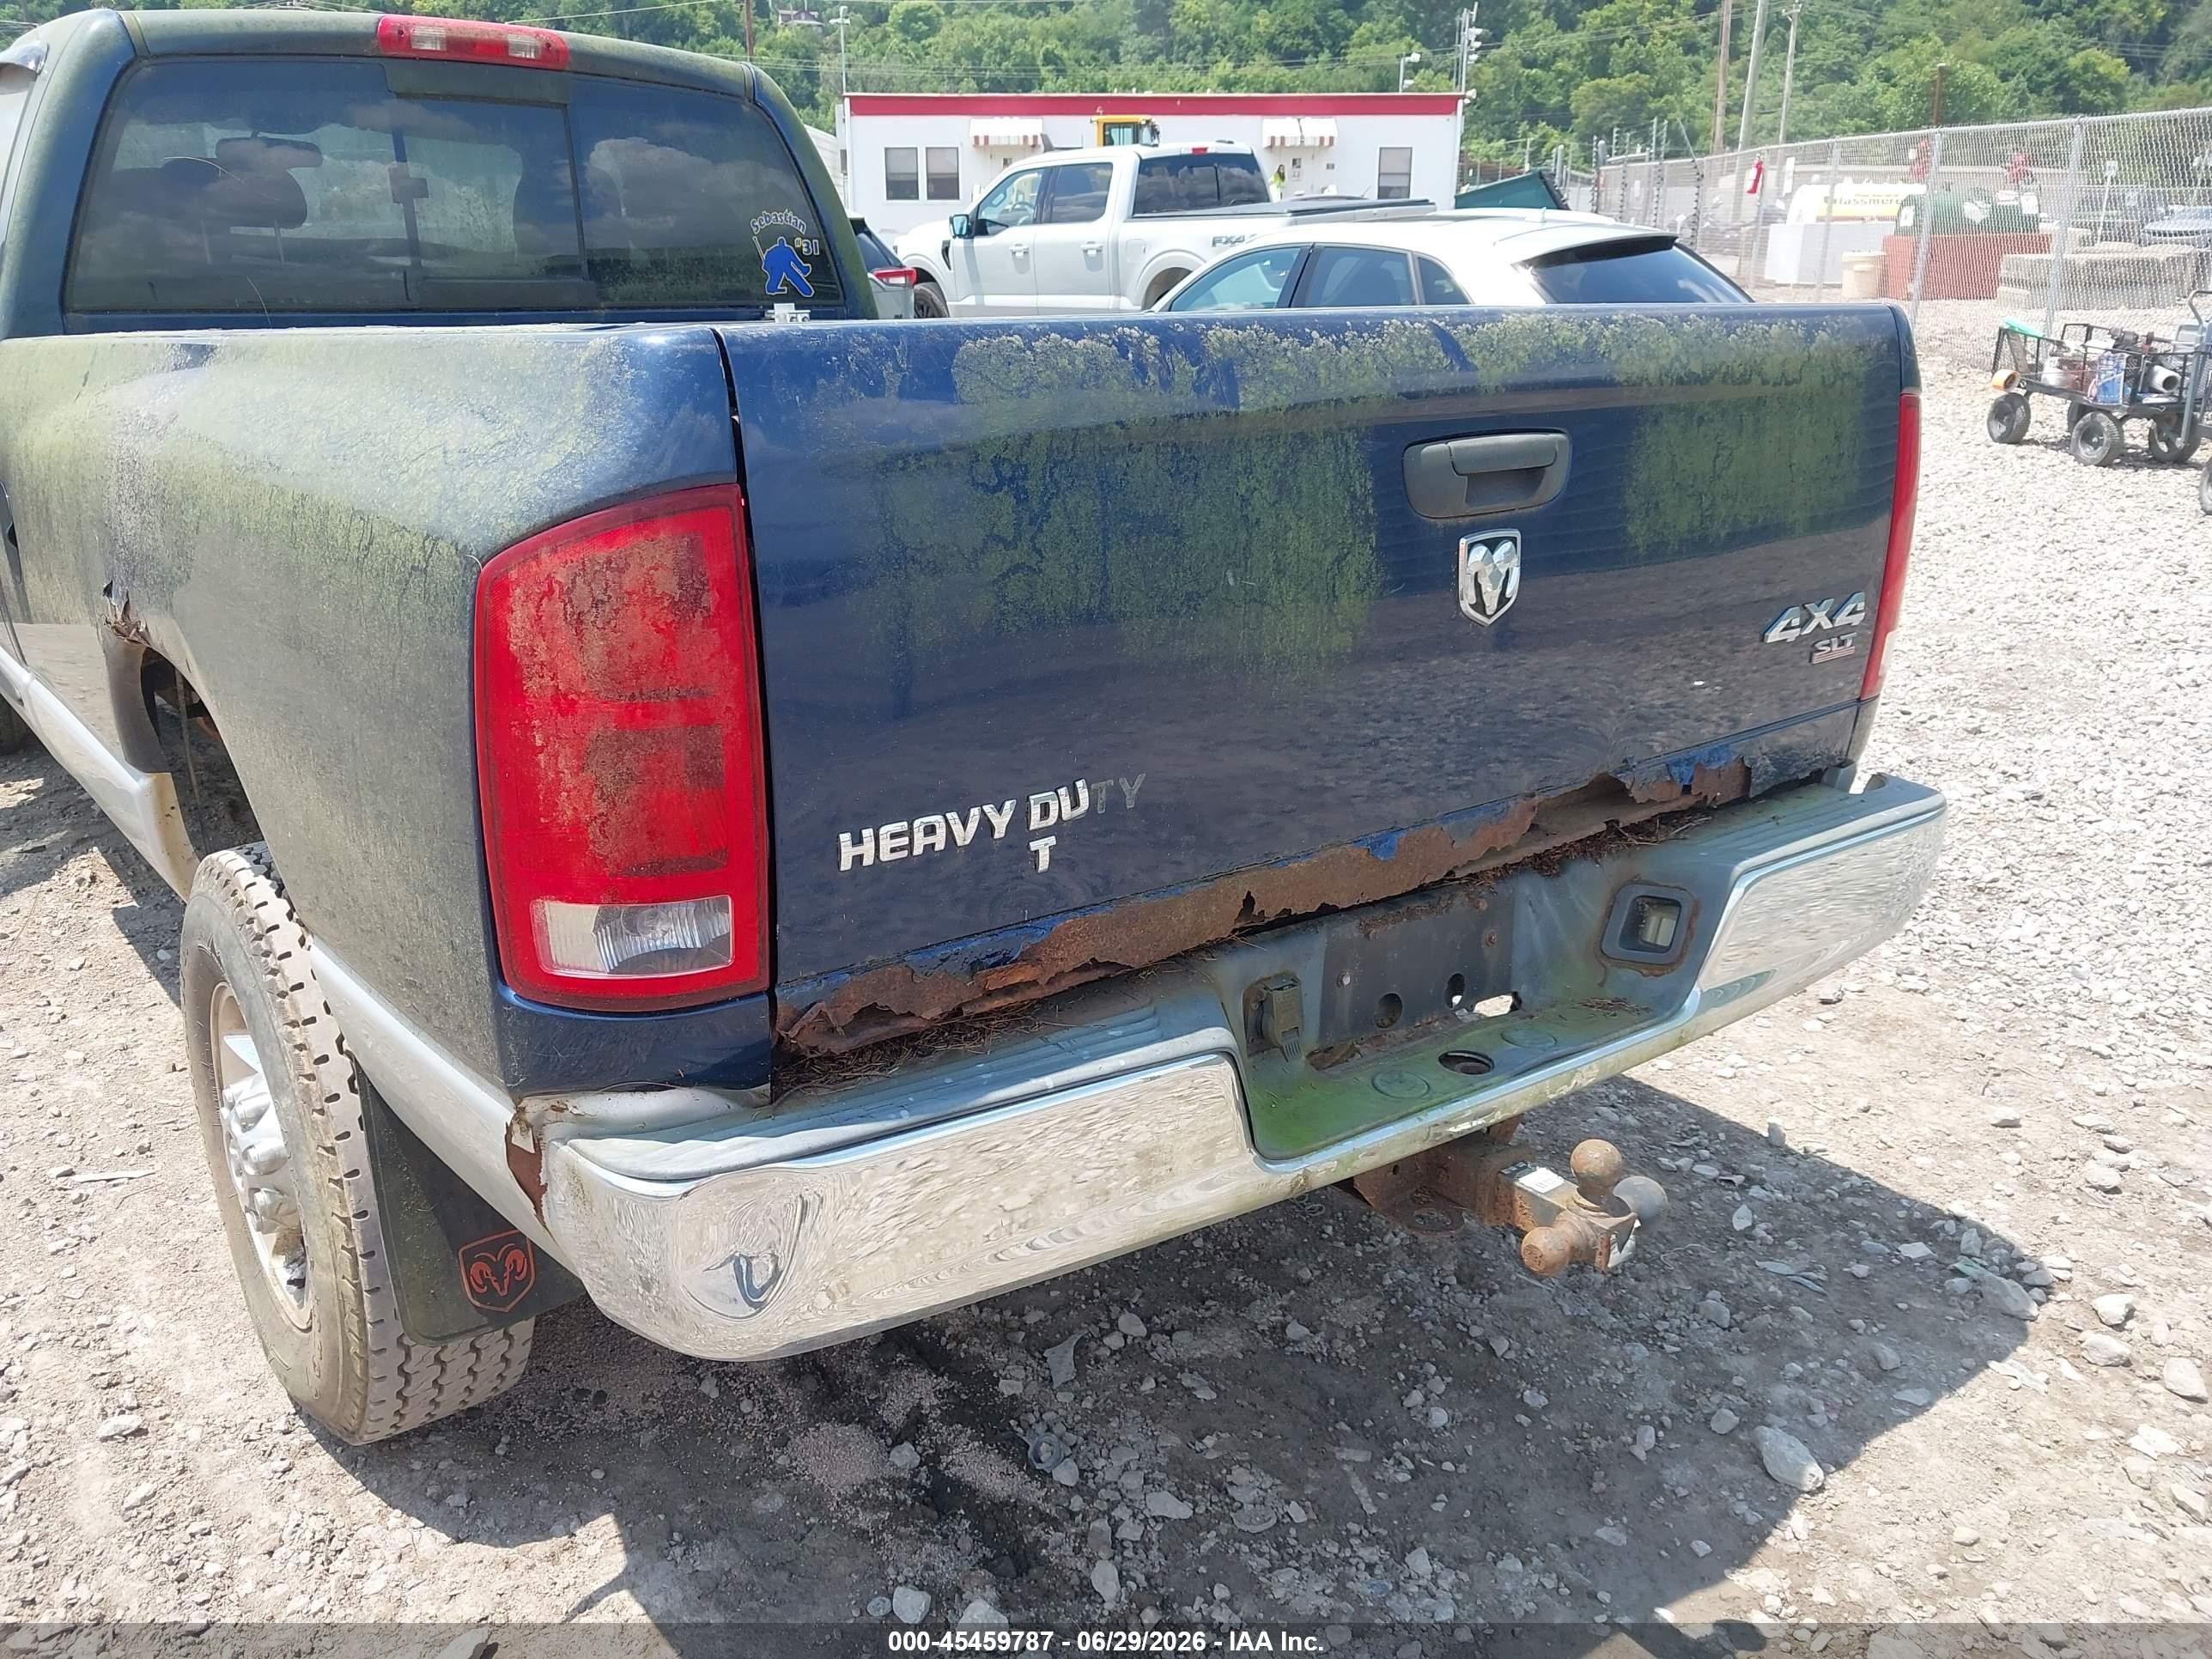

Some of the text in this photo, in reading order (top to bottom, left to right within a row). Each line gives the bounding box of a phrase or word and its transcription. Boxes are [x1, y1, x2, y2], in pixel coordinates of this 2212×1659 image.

[750, 208, 806, 234] Sebastian
[794, 237, 820, 255] #31
[1212, 234, 1246, 247] FX4
[1814, 632, 1857, 656] SLT
[837, 799, 1018, 872] HEAVY
[1028, 835, 1057, 874] T
